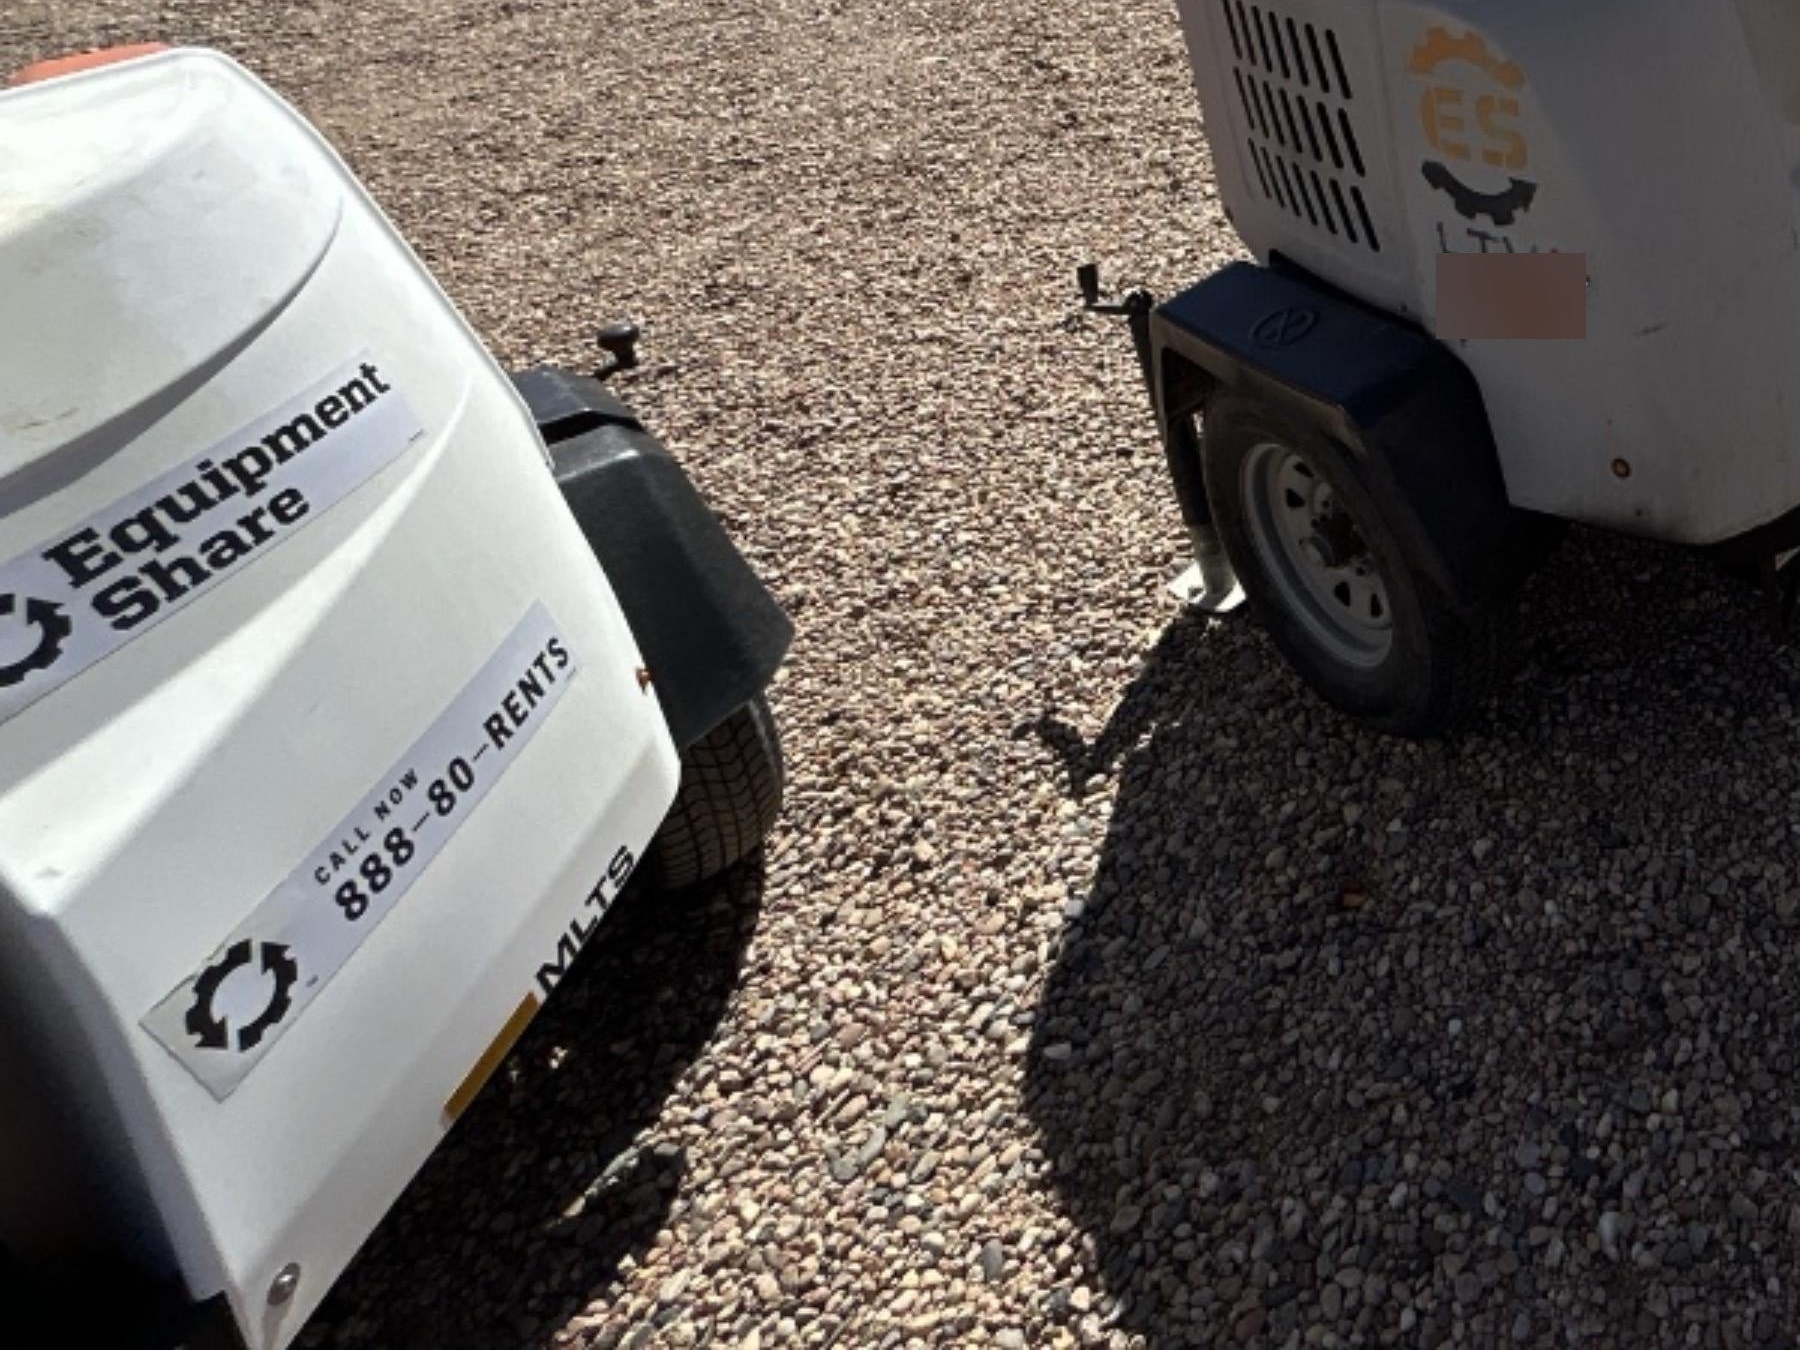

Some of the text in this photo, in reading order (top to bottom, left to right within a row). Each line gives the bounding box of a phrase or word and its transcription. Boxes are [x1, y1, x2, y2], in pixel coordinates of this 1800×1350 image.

[1419, 86, 1529, 172] ES
[41, 361, 391, 589] Equipment
[90, 487, 310, 631] Share
[314, 767, 420, 886] CALL NOW
[335, 637, 569, 922] 888-80-RENTS
[535, 844, 635, 996] MLTS
